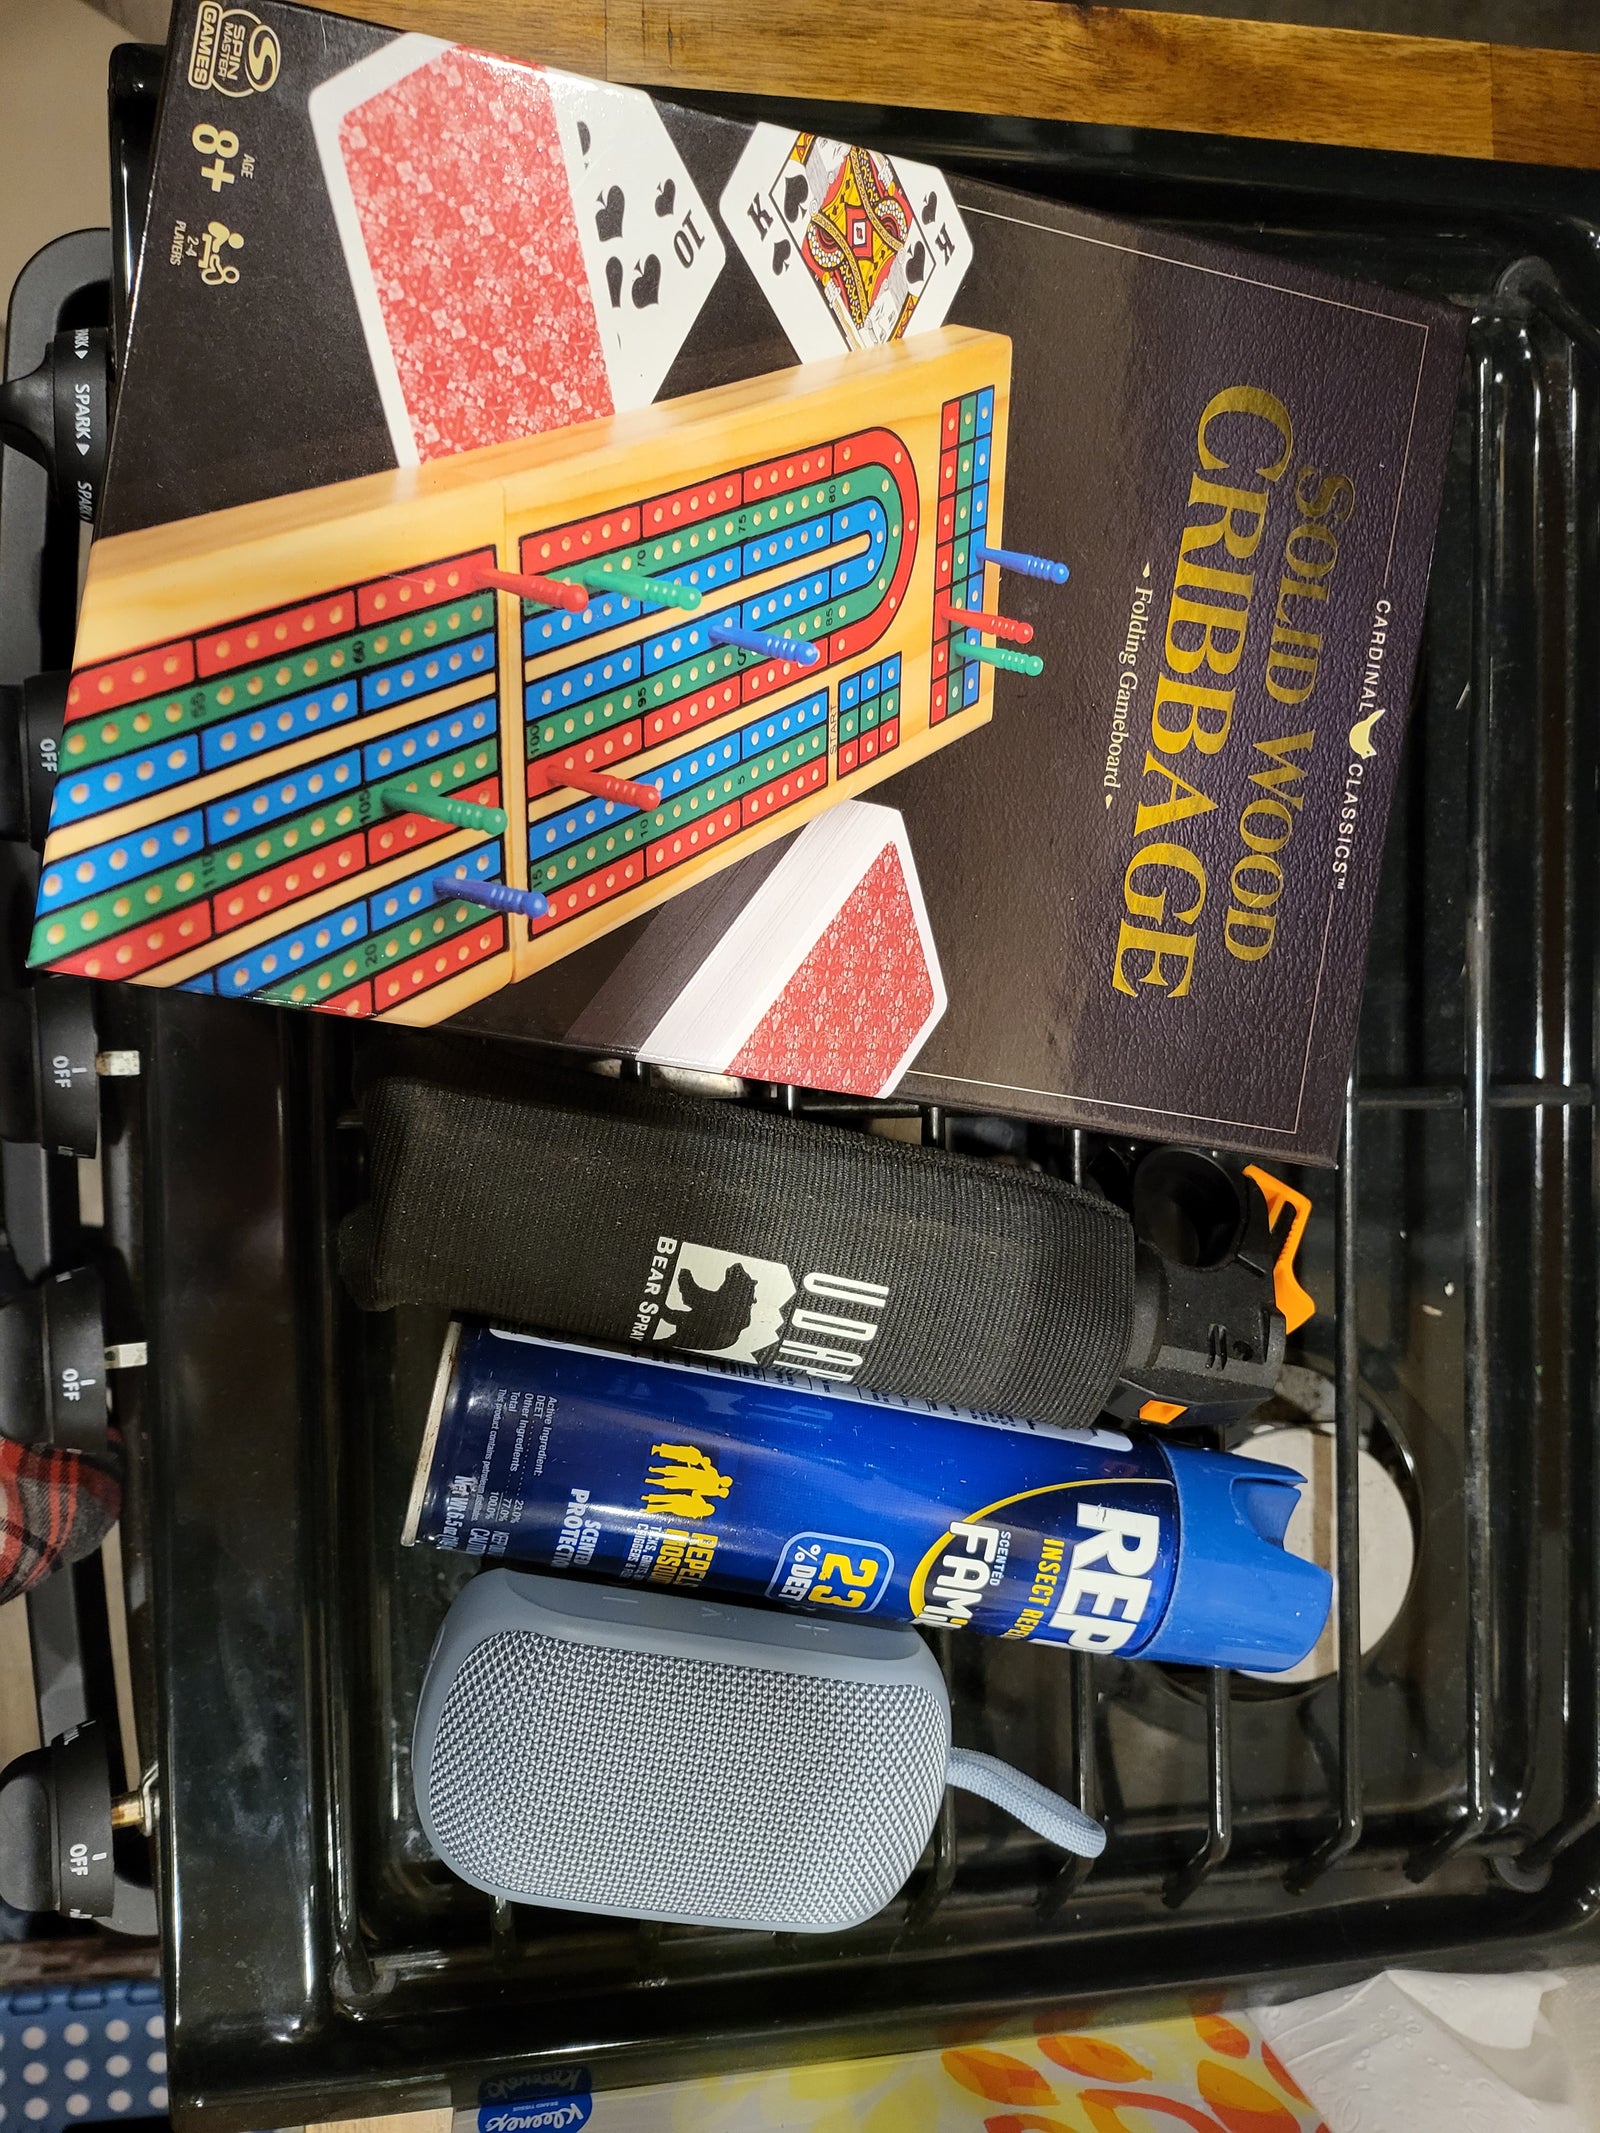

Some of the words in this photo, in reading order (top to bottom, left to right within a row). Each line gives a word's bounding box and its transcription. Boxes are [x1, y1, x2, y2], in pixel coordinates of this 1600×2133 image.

[192, 7, 218, 84] GAMES
[217, 21, 233, 79] MASTER
[226, 24, 246, 81] SPIN
[191, 123, 240, 193] 8+
[240, 153, 255, 180] AGE
[746, 193, 773, 242] K
[169, 220, 187, 266] PLAYERS
[184, 235, 200, 258] 2-4
[673, 210, 706, 270] 10
[934, 222, 955, 266] K
[74, 328, 89, 349] PARK
[74, 384, 92, 440] SPARK
[738, 514, 747, 534] 75
[1264, 464, 1356, 705] SOLID
[825, 608, 834, 627] 85
[1118, 585, 1153, 666] Folding
[1358, 600, 1392, 713] CARDINAL
[1111, 386, 1294, 998] CRIBBAGE
[529, 725, 540, 755] 100
[829, 704, 838, 756] START
[1103, 671, 1138, 788] Gameboard
[39, 738, 57, 772] OFF
[639, 819, 649, 838] 10
[1223, 730, 1315, 962] WOOD
[52, 1056, 72, 1088] OFF
[644, 1236, 678, 1295] BEAR
[628, 1301, 660, 1342] SPRAY
[61, 1368, 80, 1401] OFF
[497, 1389, 507, 1402] This
[508, 1391, 521, 1413] Total
[490, 1402, 503, 1430] product
[521, 1393, 534, 1418] Other
[533, 1395, 546, 1419] DEET
[544, 1396, 557, 1425] Active
[484, 1430, 497, 1460] contains
[509, 1420, 529, 1472] Ingredients
[533, 1426, 552, 1477] Ingredient:
[475, 1460, 491, 1494] petroleum
[444, 1511, 465, 1527] 6.5
[484, 1491, 500, 1520] 100.0%
[497, 1498, 512, 1522] 77.0%
[509, 1499, 524, 1524] 23.0%
[550, 1488, 591, 1568] PROTECTIO
[574, 1520, 601, 1566] SCENTED
[643, 1526, 662, 1553] TCKS,
[672, 1532, 719, 1588] REPELS
[794, 1544, 821, 1562] %
[989, 1531, 1012, 1586] SCENTED
[1028, 1538, 1065, 1607] INSECT
[778, 1563, 817, 1601] DEET
[807, 1553, 879, 1608] 23
[1029, 1503, 1160, 1655] REP
[69, 1843, 88, 1876] OFF
[484, 2103, 584, 2132] Kleenex
